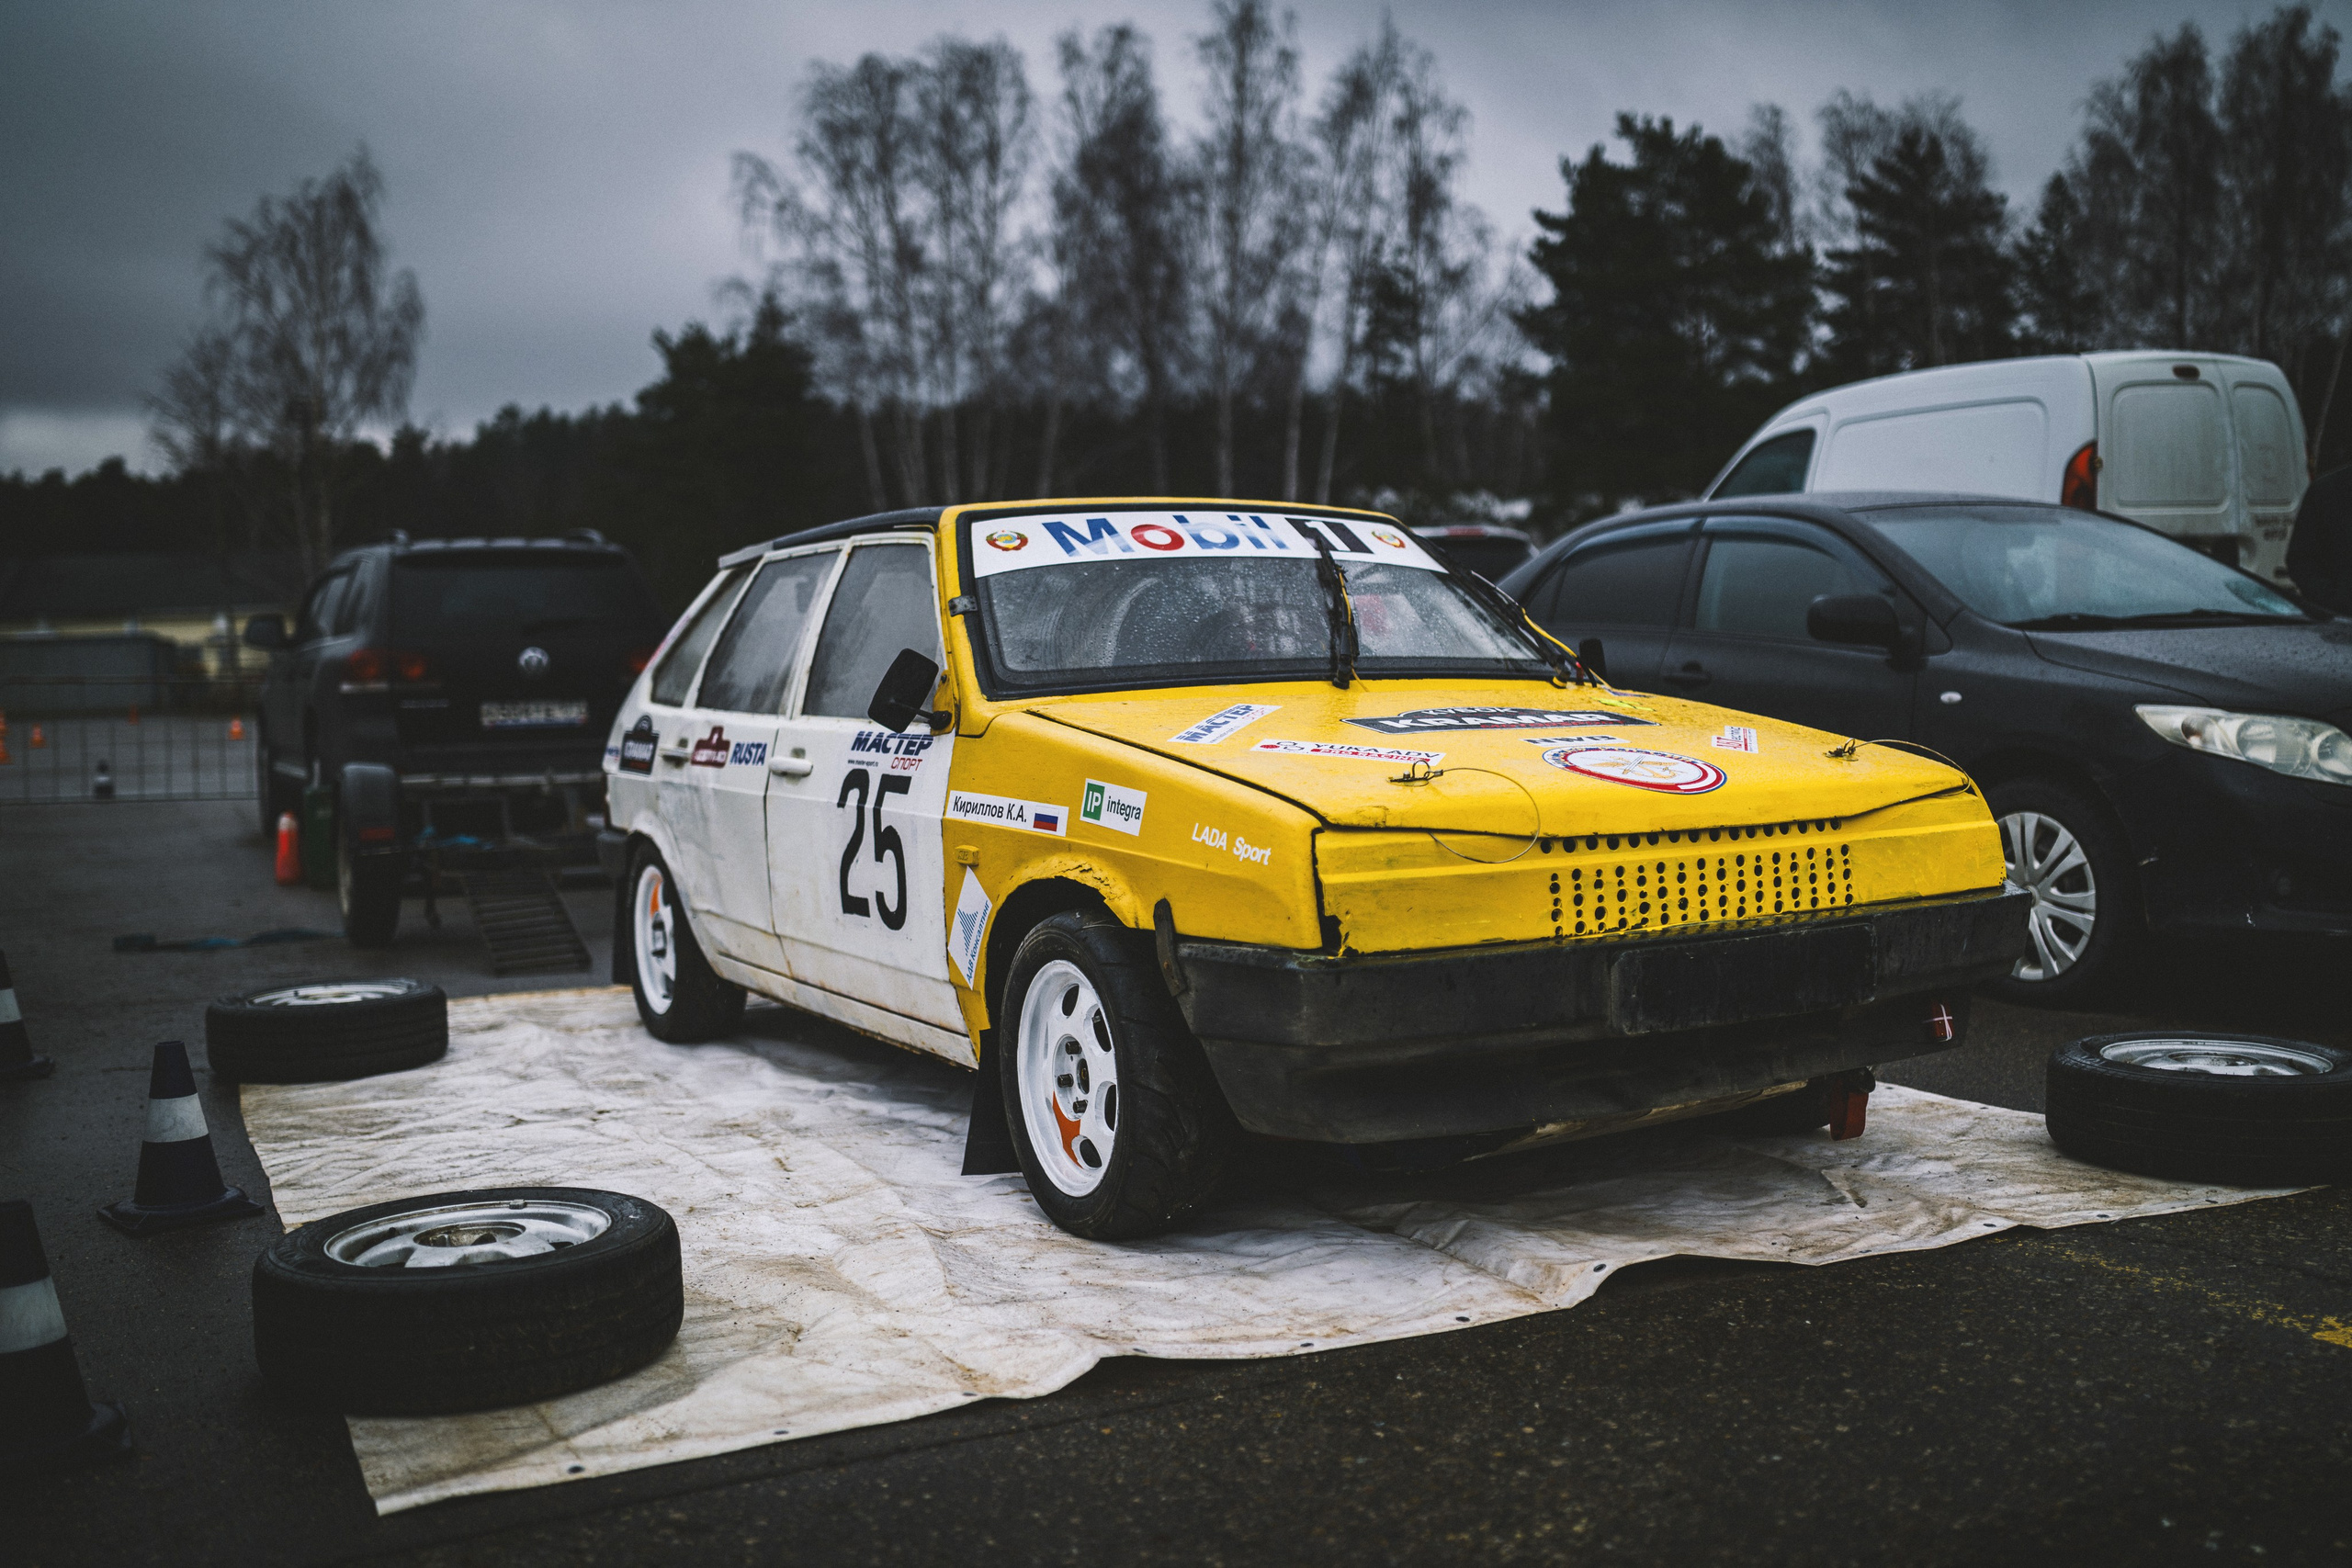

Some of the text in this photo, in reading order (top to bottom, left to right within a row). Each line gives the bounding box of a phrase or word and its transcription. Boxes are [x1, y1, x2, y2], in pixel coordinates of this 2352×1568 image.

[1041, 514, 1288, 558] Mobil
[1379, 714, 1621, 728] KRAMAR
[729, 742, 767, 766] RUSTA
[851, 731, 934, 756] МАСТЕР
[1315, 743, 1379, 753] YUKA
[891, 757, 922, 771] СПОРТ
[953, 795, 1027, 823] Кириллов К.А.
[1086, 791, 1142, 822] IP integra
[837, 768, 912, 931] 25
[1192, 822, 1272, 865] LADA Sport
